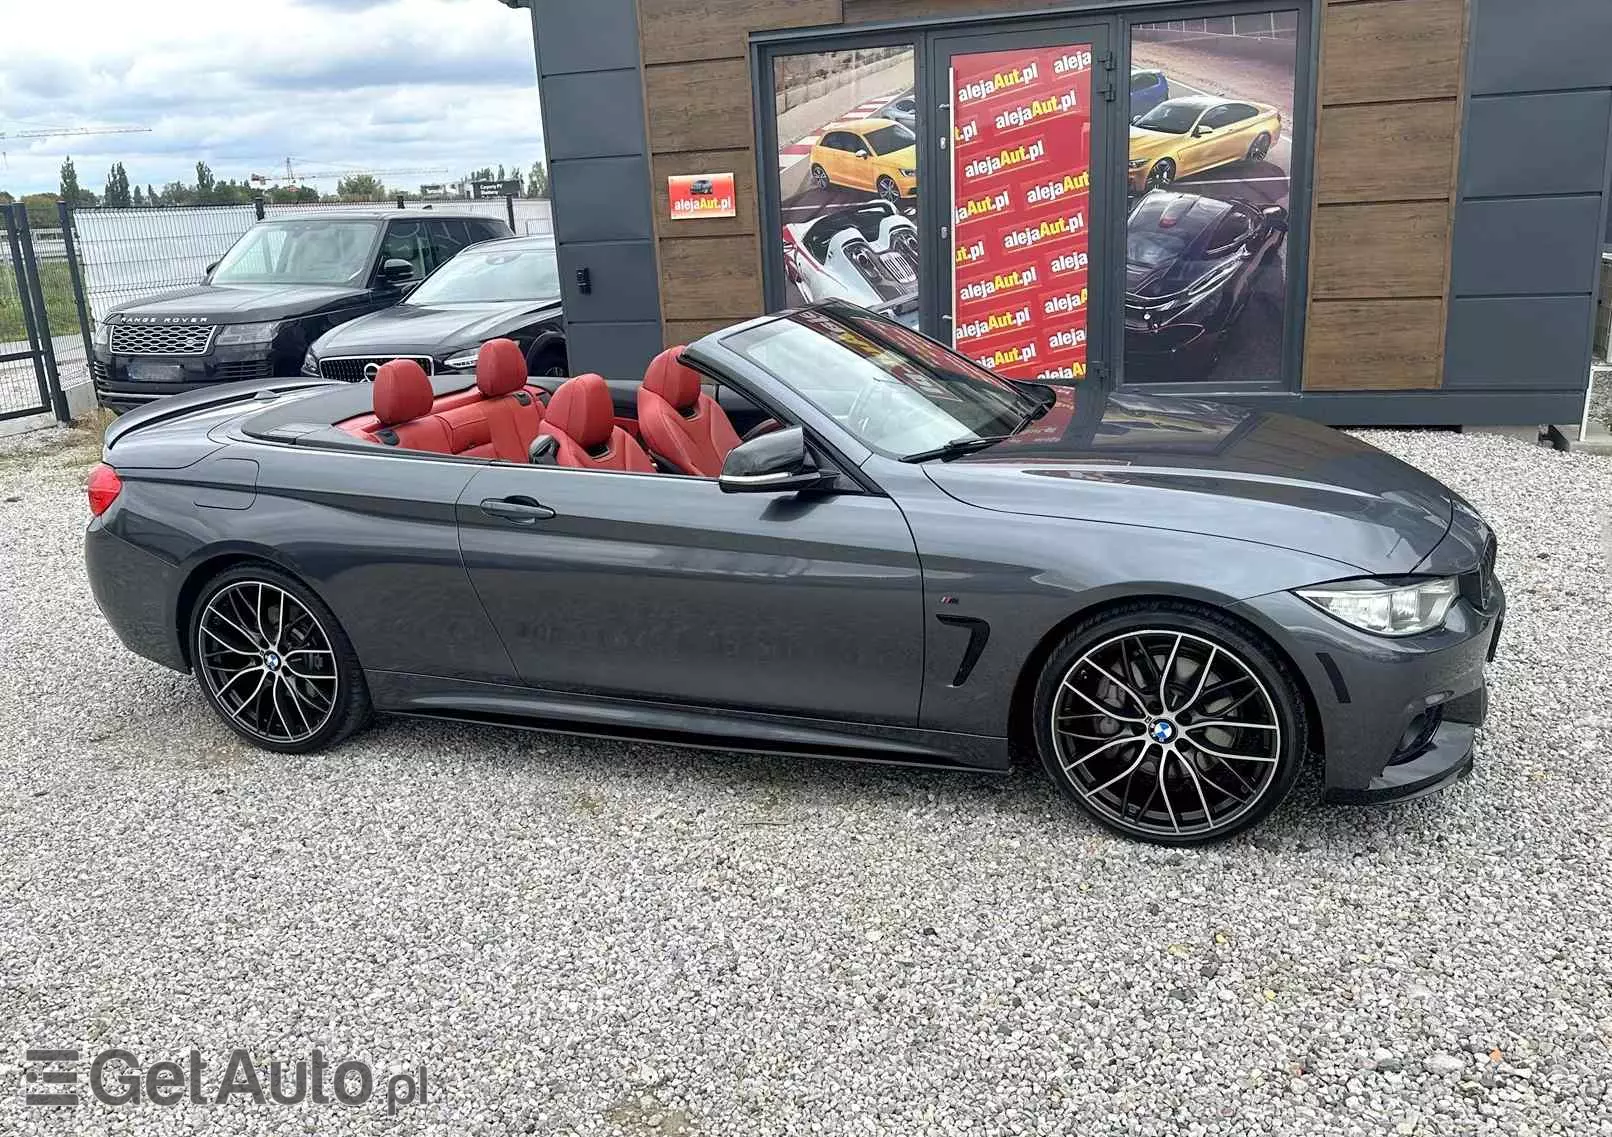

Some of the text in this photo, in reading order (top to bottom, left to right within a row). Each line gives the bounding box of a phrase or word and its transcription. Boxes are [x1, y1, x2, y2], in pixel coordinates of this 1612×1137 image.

[1053, 50, 1091, 74] aleja
[958, 62, 1039, 102] alejaAut.pl
[995, 88, 1077, 129] alejaAut.pl
[965, 139, 1045, 178] alejaAut.pl
[1026, 171, 1089, 203] alejaAut
[674, 196, 731, 212] alejaAut.pl
[1003, 212, 1084, 248] alejaAut.pl
[1050, 251, 1088, 273] aleja
[960, 266, 1038, 300] alejaAut.pl
[120, 316, 208, 324] RANGE ROVER
[955, 306, 1031, 340] alejaAut.pl
[1048, 328, 1086, 348] aleja
